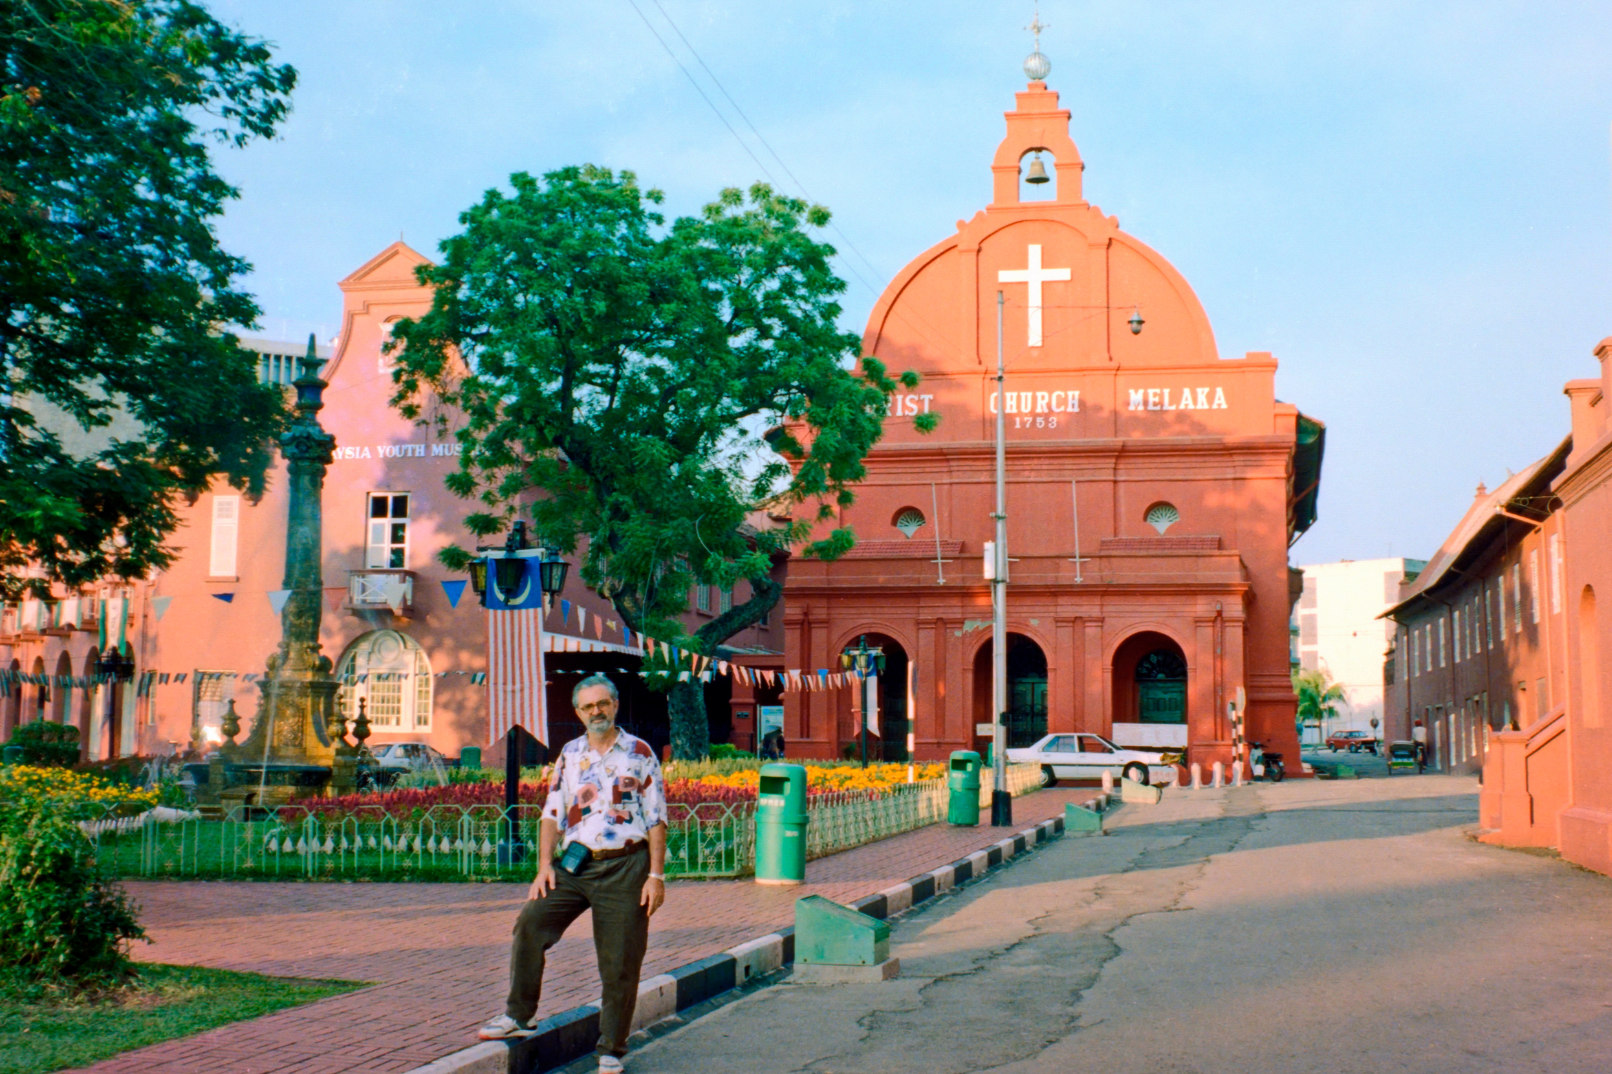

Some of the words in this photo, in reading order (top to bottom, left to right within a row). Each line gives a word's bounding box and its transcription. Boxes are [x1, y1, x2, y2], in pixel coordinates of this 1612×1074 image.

[989, 390, 1080, 414] CHURCH
[1128, 387, 1229, 411] MELAKA
[1014, 416, 1057, 429] 1753
[377, 444, 426, 458] YOUTH
